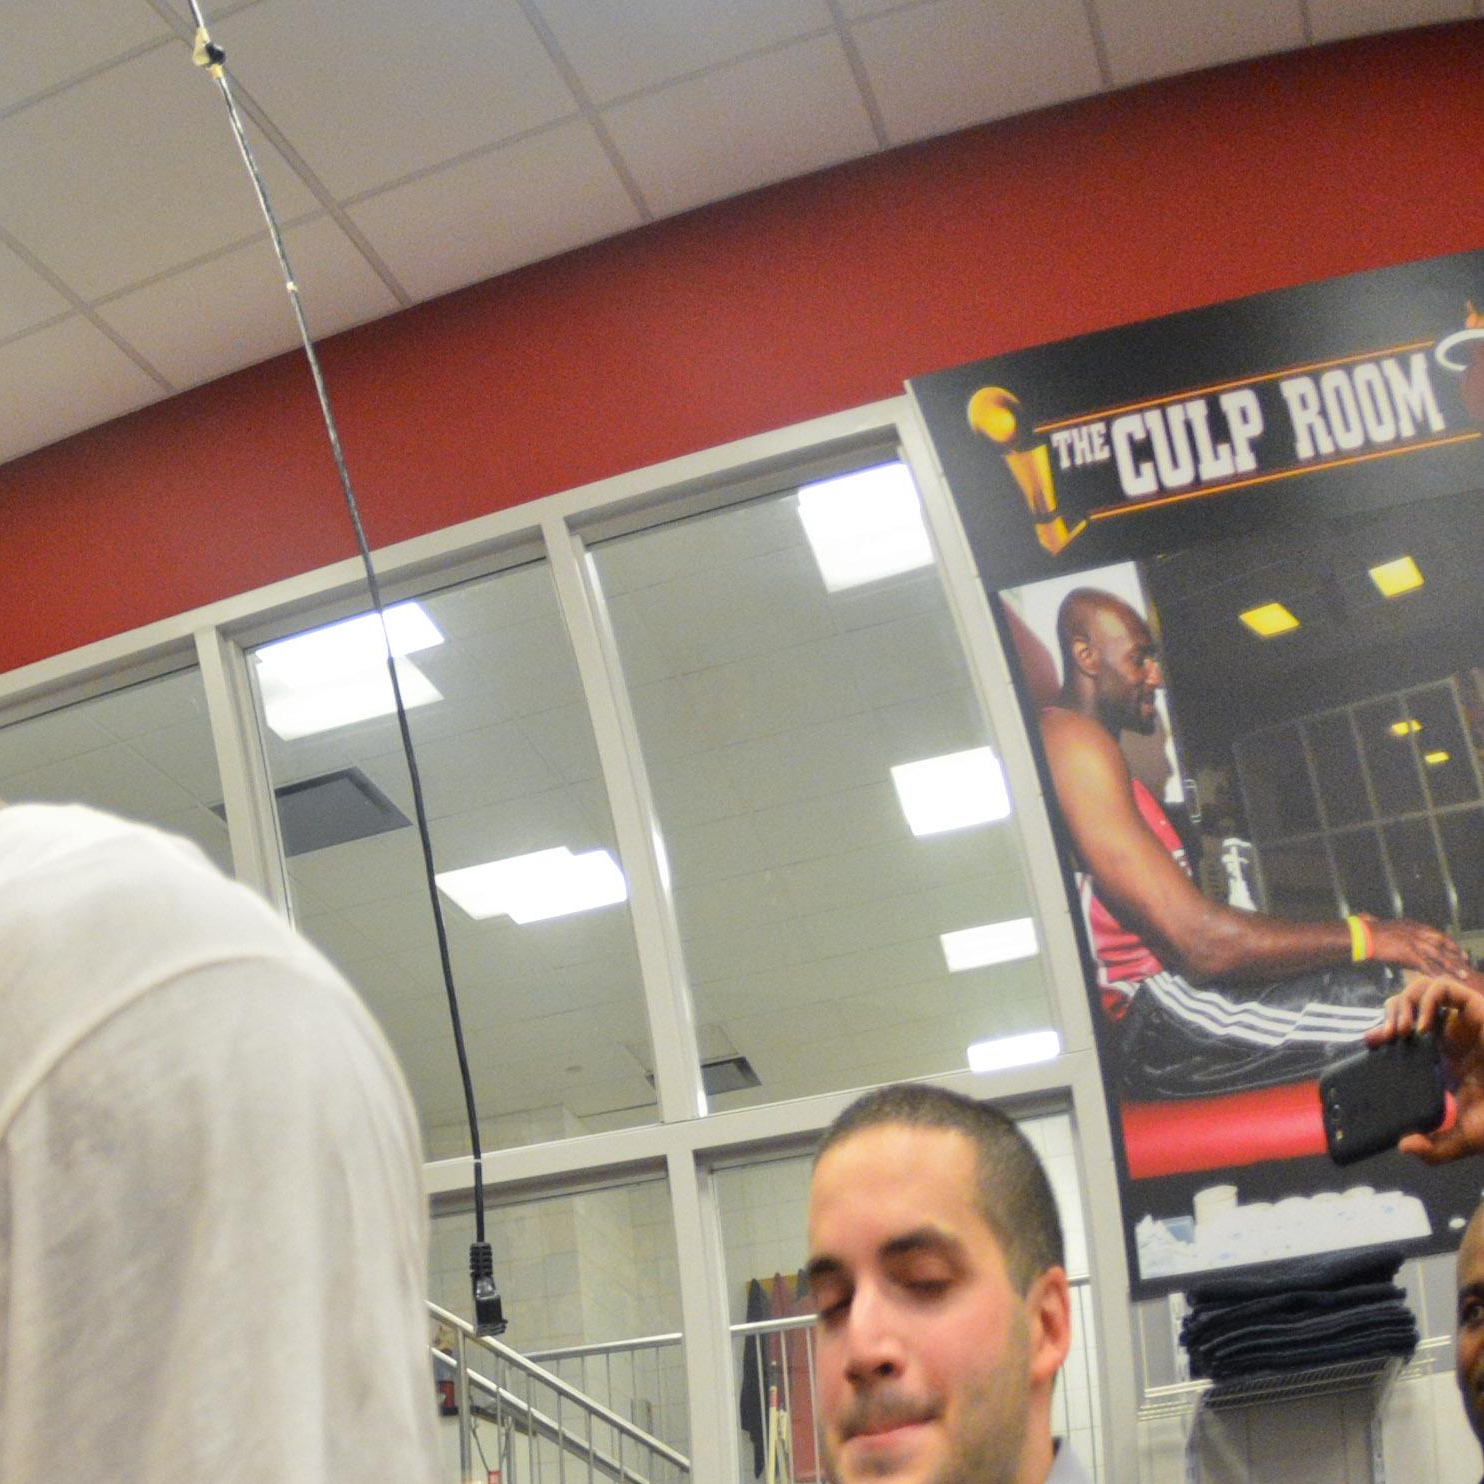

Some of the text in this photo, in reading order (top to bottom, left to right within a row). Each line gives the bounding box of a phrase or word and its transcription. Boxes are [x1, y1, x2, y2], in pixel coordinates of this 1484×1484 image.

[1050, 351, 1447, 498] THE CULP ROOM
